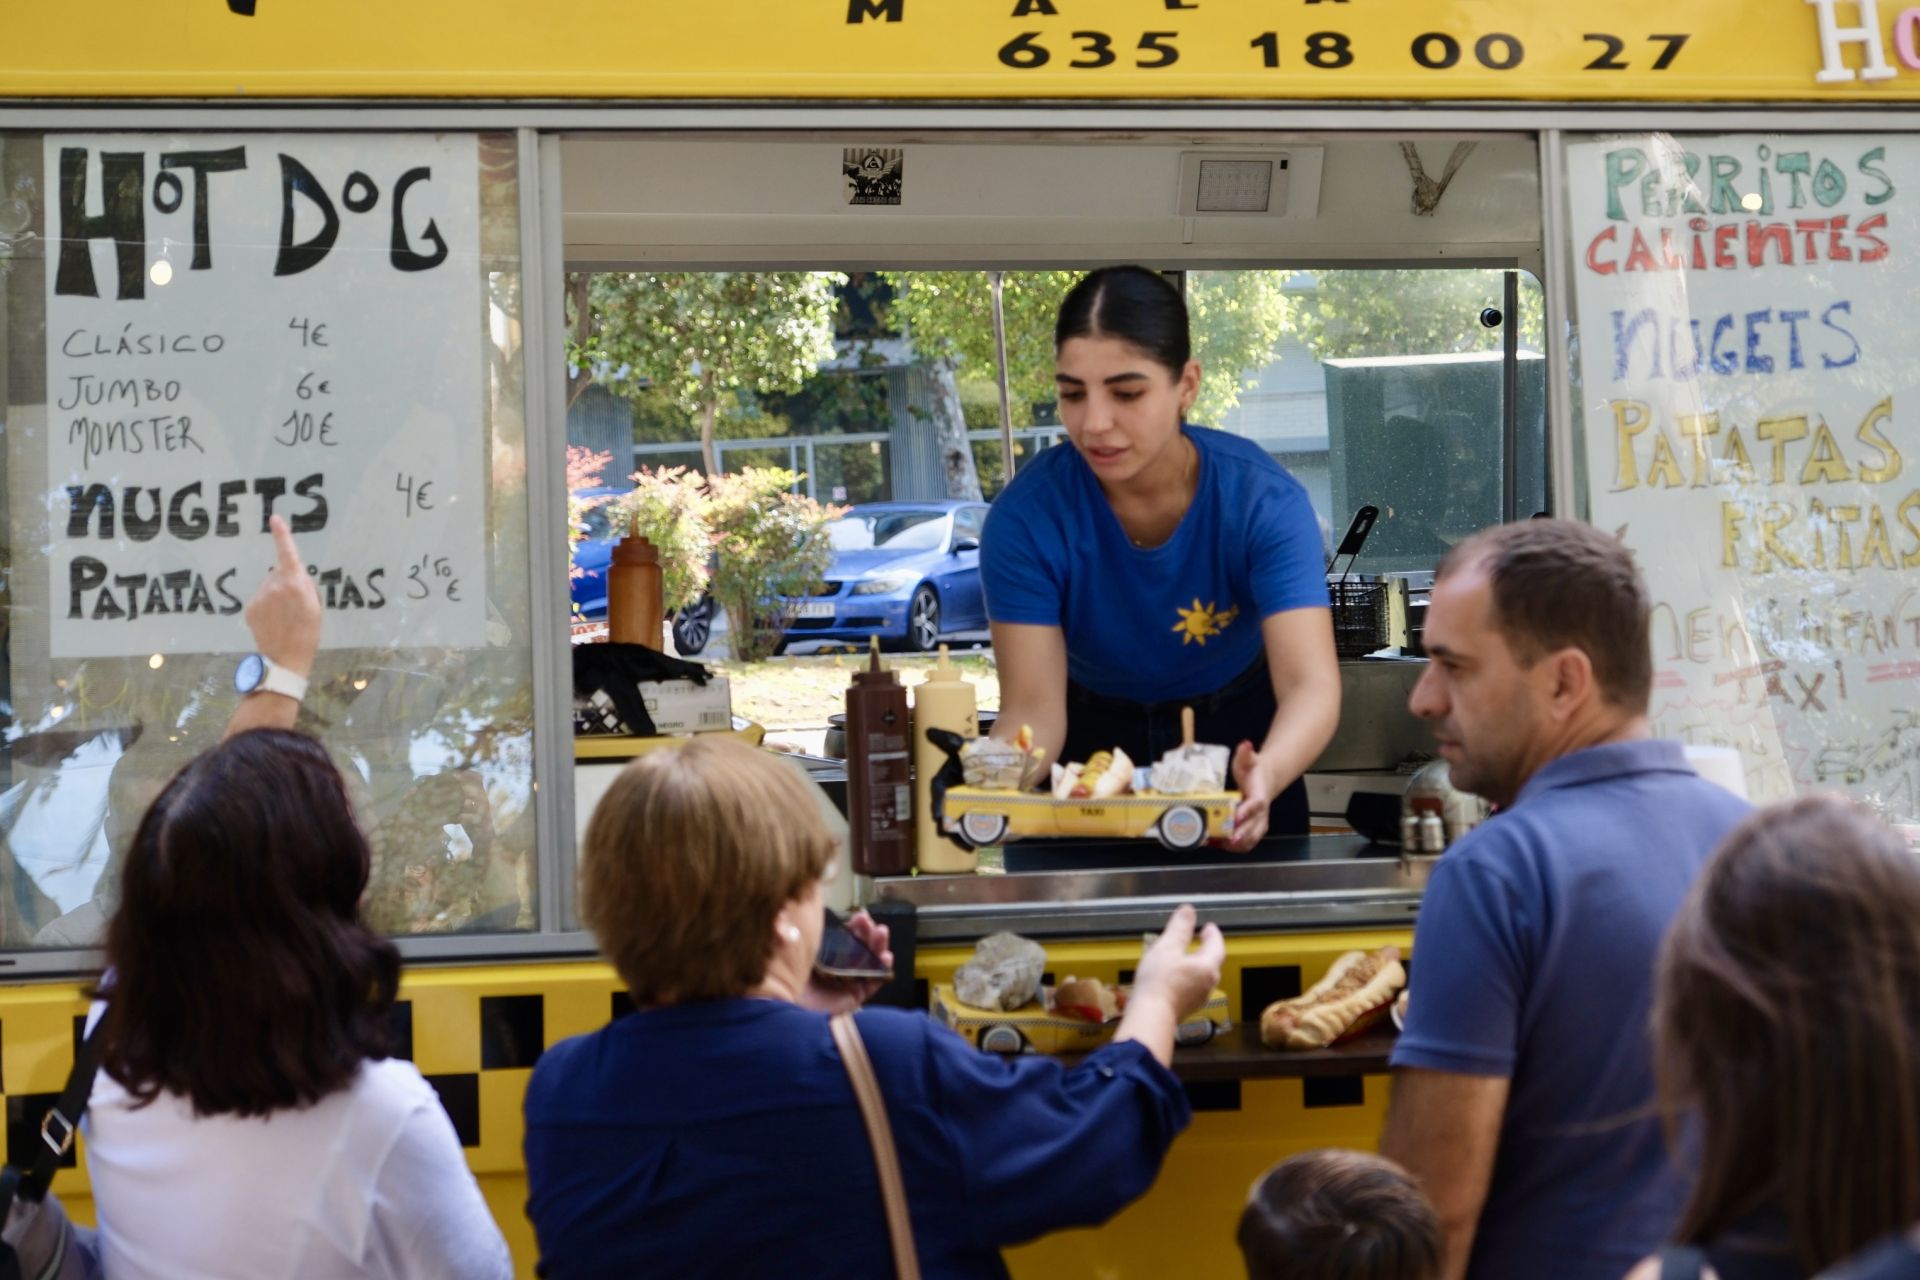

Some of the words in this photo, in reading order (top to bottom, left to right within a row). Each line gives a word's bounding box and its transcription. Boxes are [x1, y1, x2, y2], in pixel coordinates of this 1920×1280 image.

[998, 32, 1180, 69] 635
[1250, 32, 1354, 69] 18
[1411, 32, 1525, 70] 00
[1582, 33, 1691, 70] 27
[54, 145, 248, 300] HOT
[273, 153, 449, 276] DOG
[62, 322, 225, 358] CLÁSICO
[288, 317, 329, 348] 4€
[58, 374, 181, 410] JUMBO
[295, 372, 332, 400] 6€
[68, 414, 205, 469] MONSTER
[1608, 394, 1904, 493] PATATAS
[395, 471, 435, 518] 4€
[66, 555, 243, 622] PATATAS
